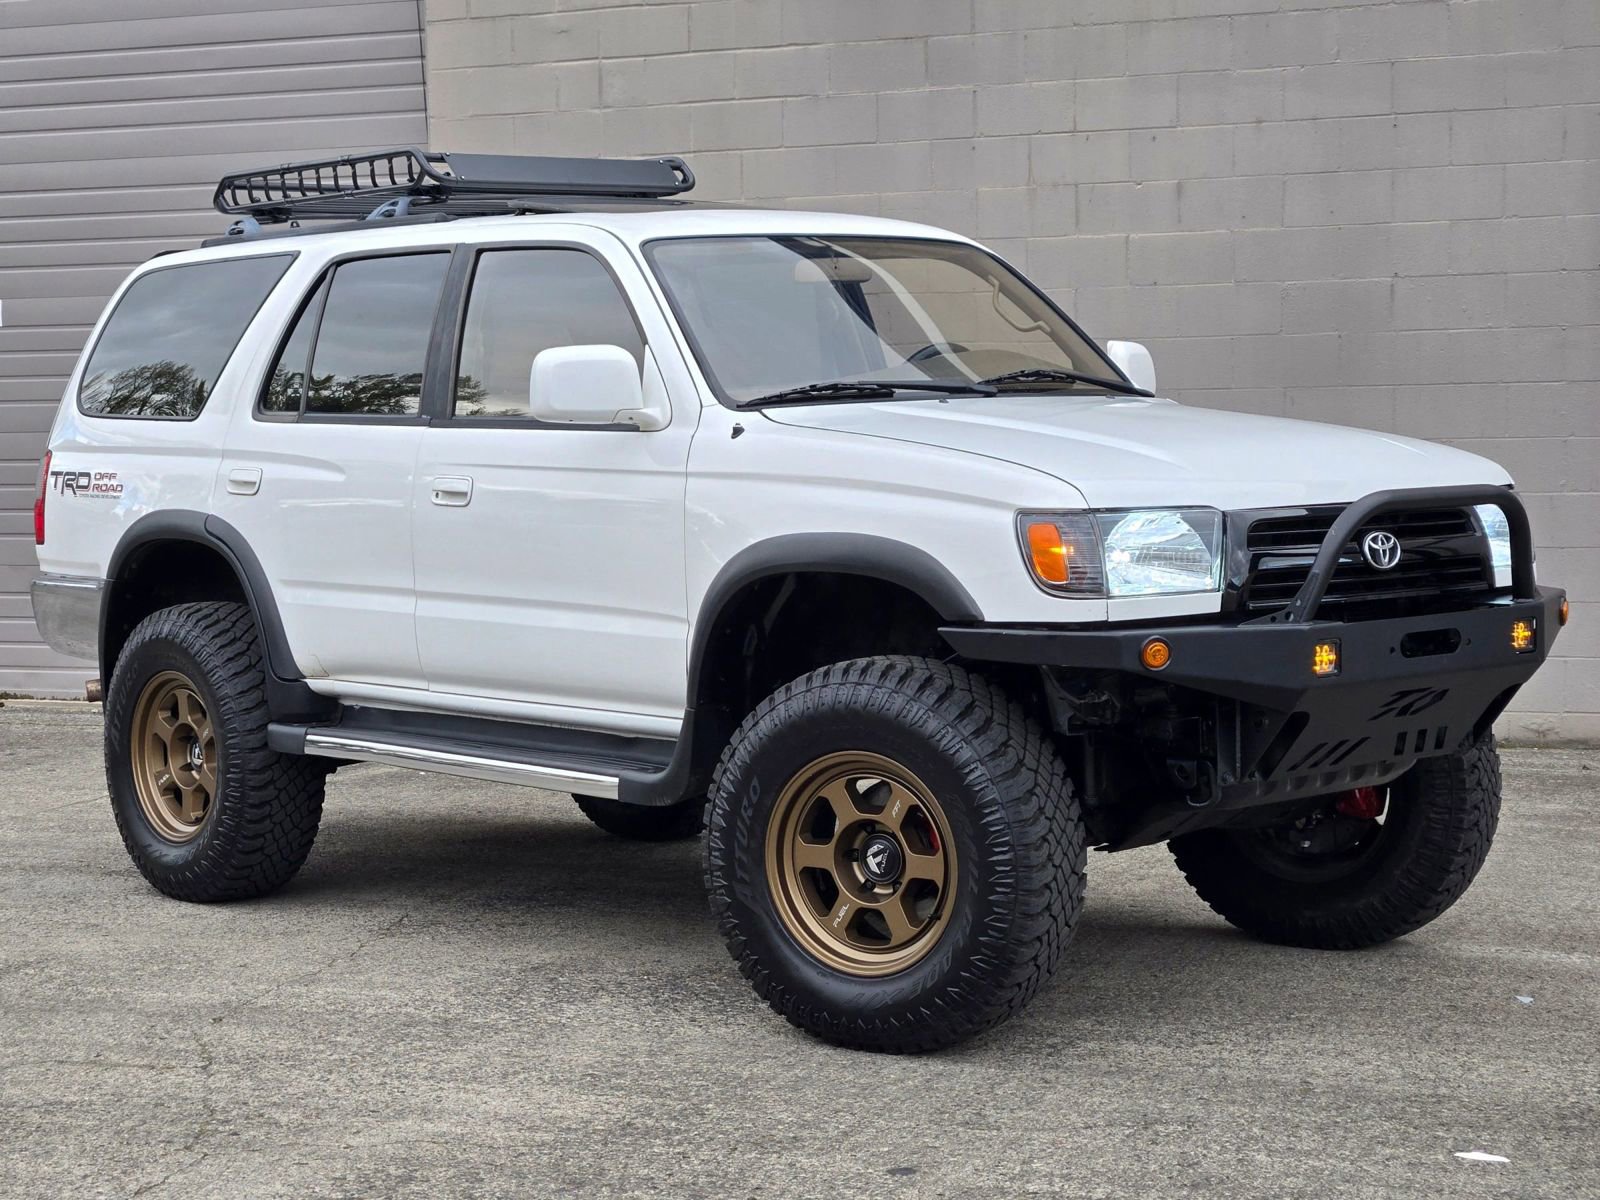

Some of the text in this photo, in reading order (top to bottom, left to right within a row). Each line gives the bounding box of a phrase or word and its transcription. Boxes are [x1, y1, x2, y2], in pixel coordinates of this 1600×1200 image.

[50, 471, 92, 497] TRD
[92, 483, 124, 493] ROAD
[94, 472, 118, 481] OFF
[732, 774, 761, 910] ATTURO
[880, 849, 890, 873] FUEL
[832, 903, 850, 928] FUEL
